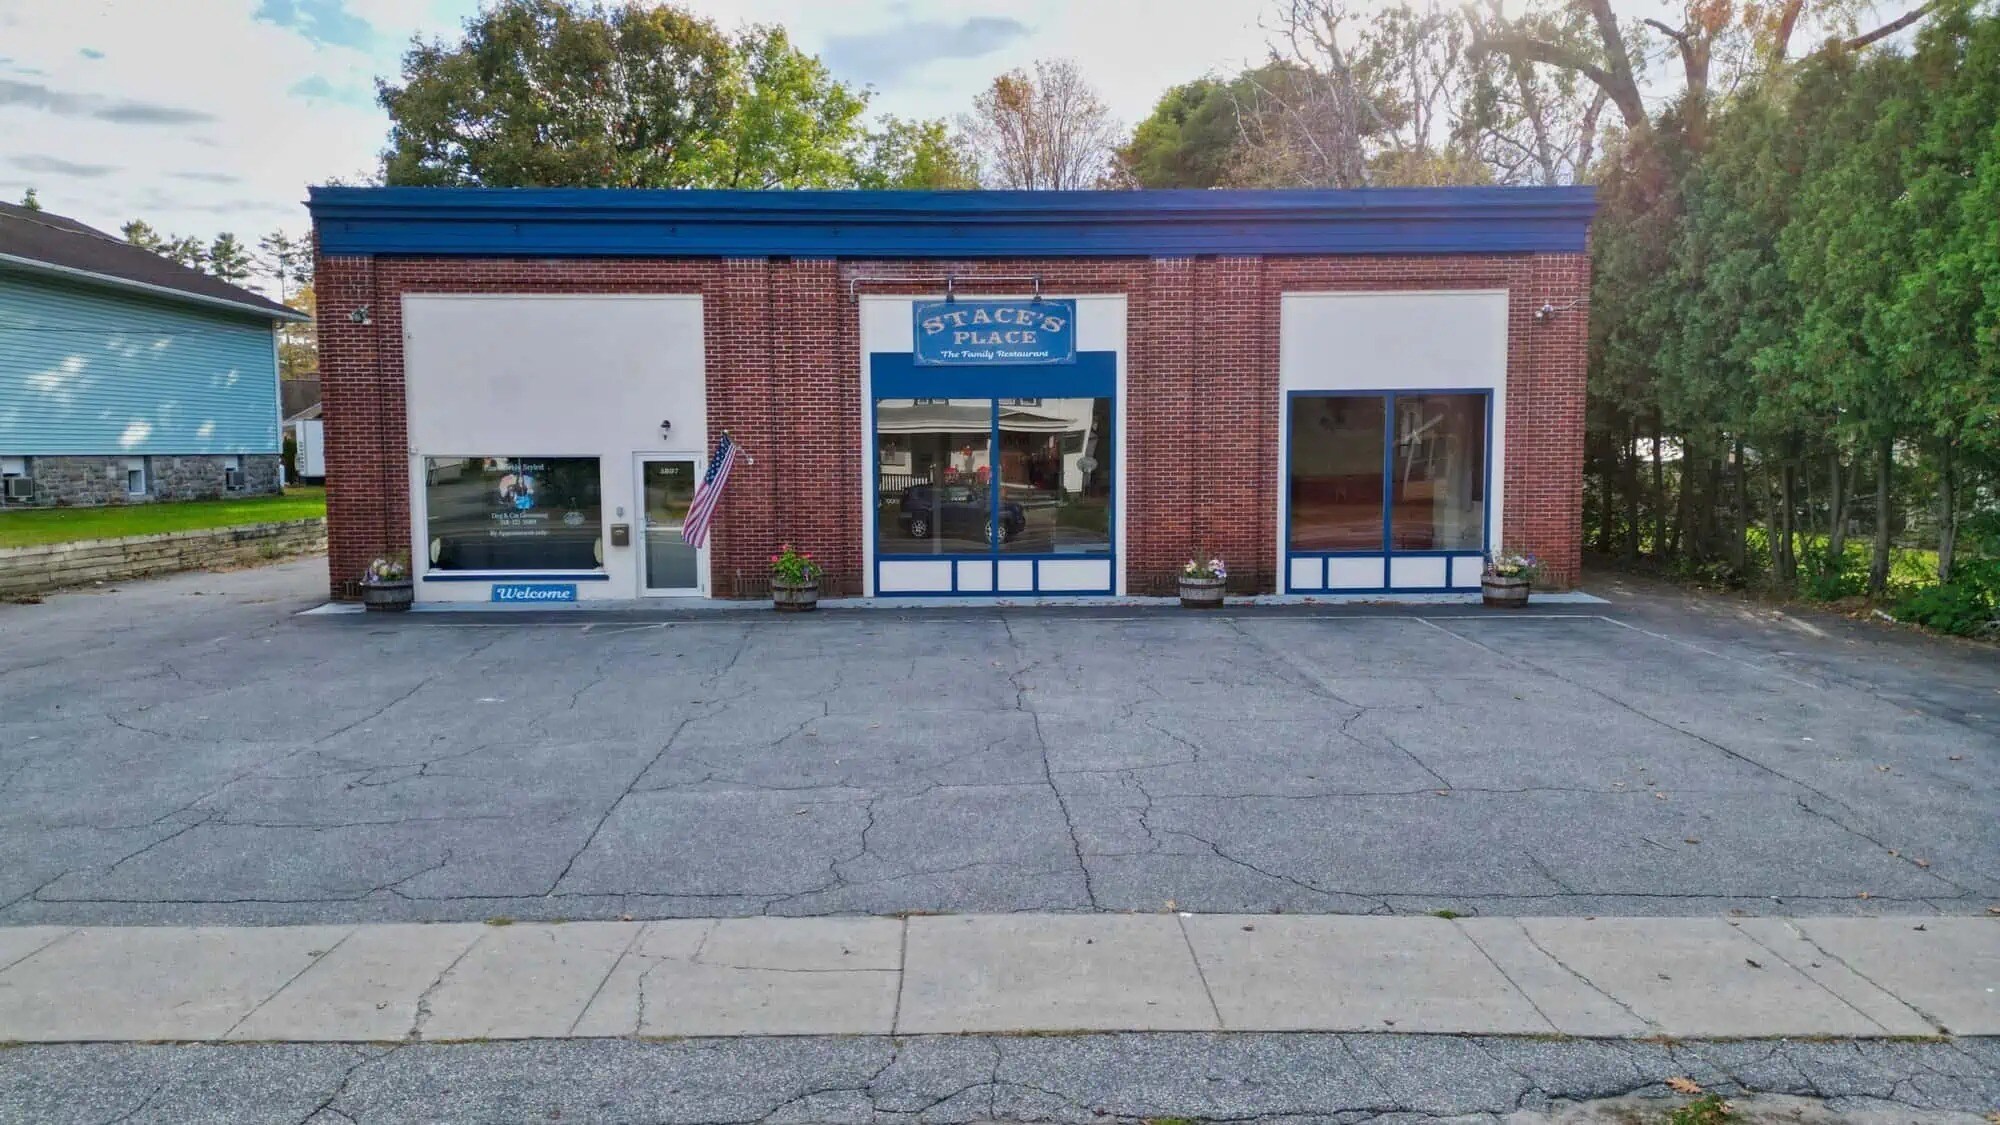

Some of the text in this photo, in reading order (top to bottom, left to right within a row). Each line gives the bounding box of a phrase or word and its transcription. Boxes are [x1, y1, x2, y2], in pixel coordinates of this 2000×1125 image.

[921, 308, 1066, 336] STACE'S
[953, 331, 1037, 345] PLACE
[940, 350, 1049, 360] The Family Restaurant
[496, 586, 570, 599] Welcome
